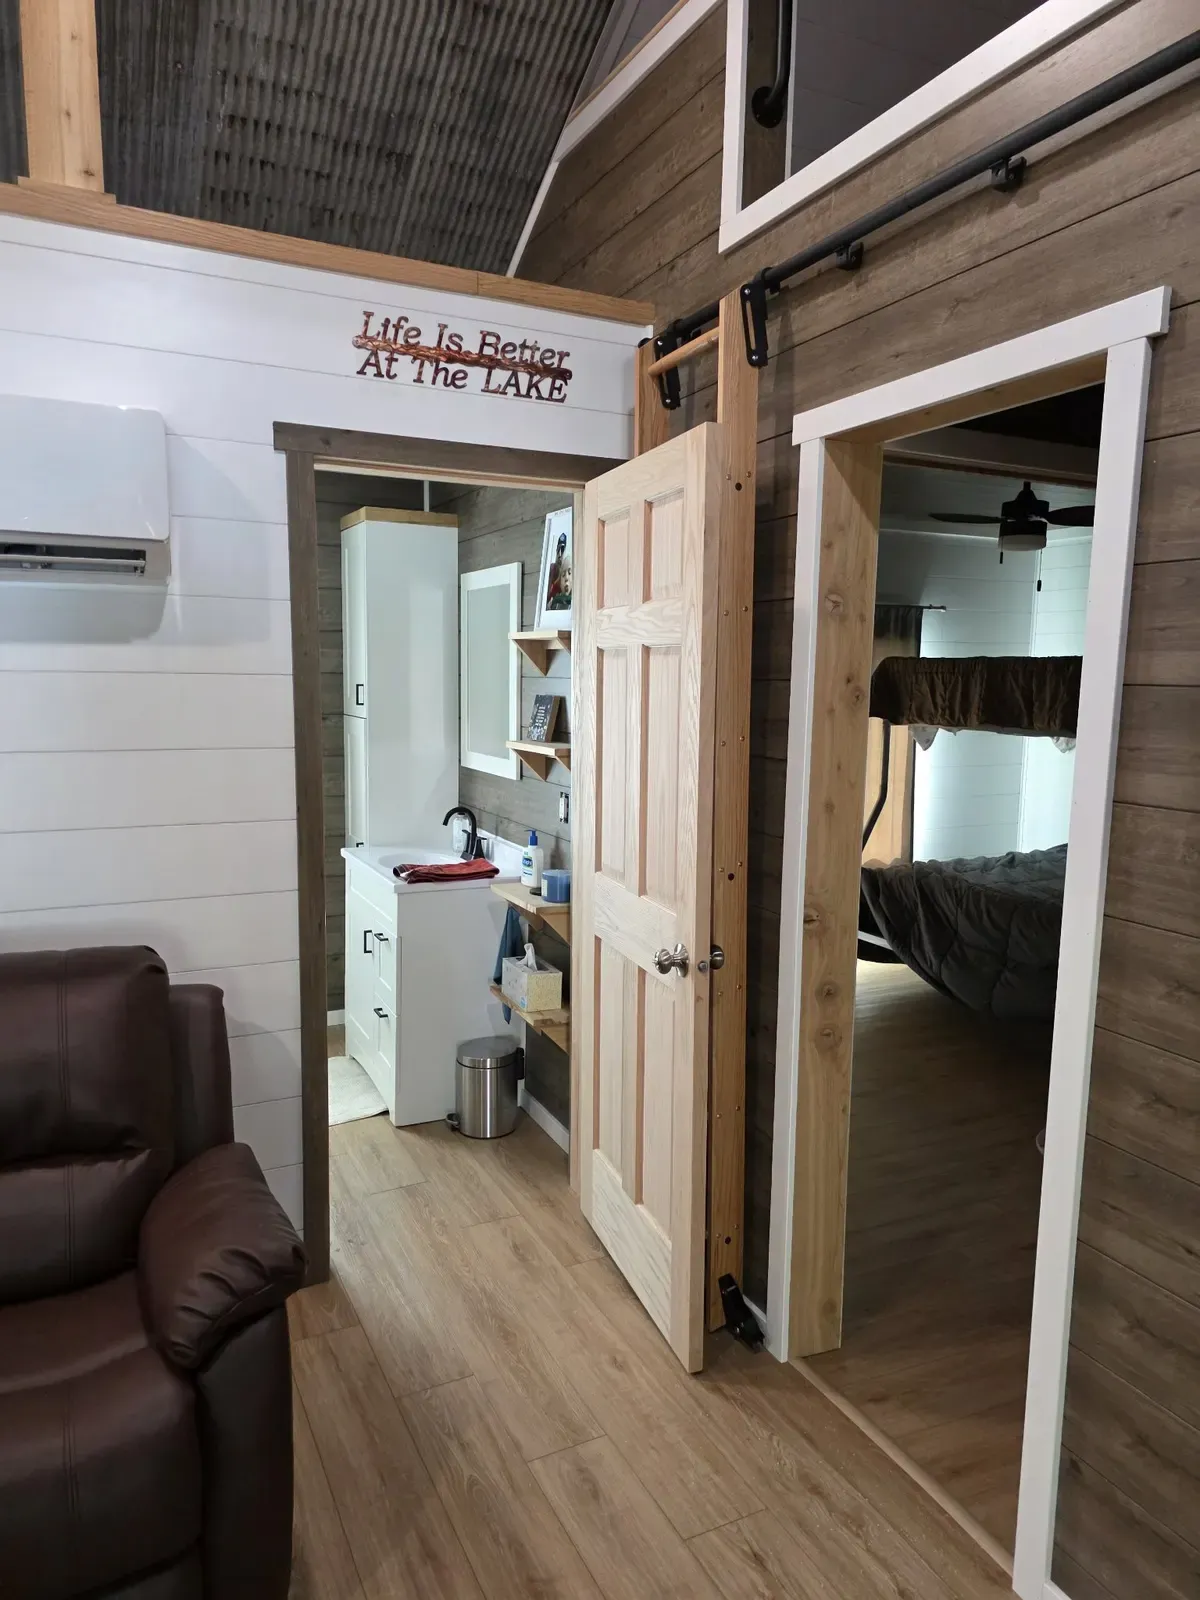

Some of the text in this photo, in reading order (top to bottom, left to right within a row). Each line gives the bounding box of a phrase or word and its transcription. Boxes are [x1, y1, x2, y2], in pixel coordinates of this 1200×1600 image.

[362, 311, 570, 368] Life Is Better
[356, 349, 569, 403] At The LAKE
